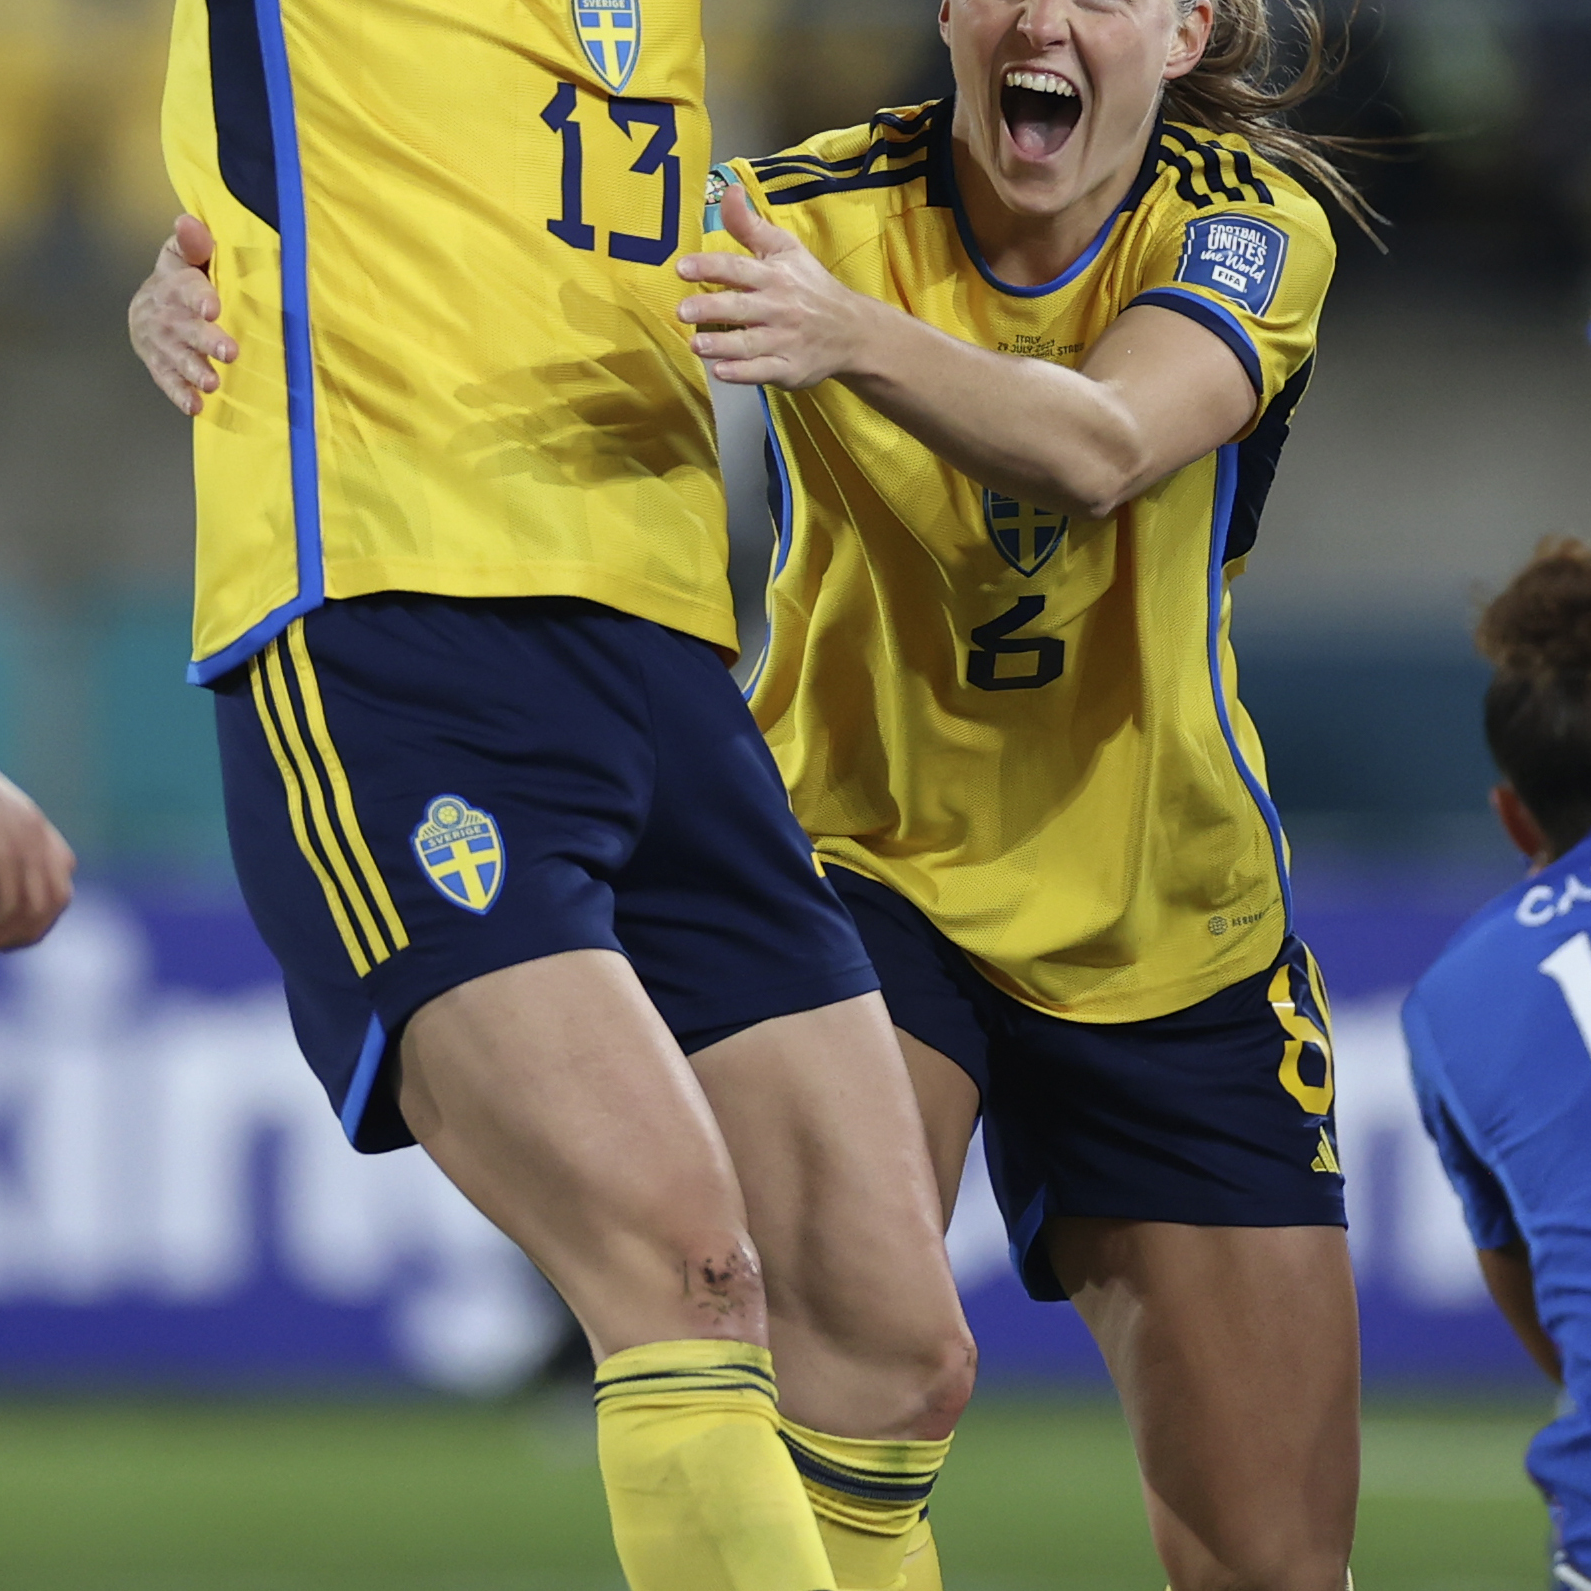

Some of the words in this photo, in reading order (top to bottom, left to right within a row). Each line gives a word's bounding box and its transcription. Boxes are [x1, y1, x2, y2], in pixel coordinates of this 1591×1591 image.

[540, 81, 681, 267] 13
[1207, 232, 1267, 266] UNITES
[1210, 224, 1267, 250] FOOTBALL
[1218, 270, 1241, 287] FIFA
[1225, 251, 1266, 285] World
[1010, 344, 1033, 354] JULY
[1015, 334, 1042, 344] ITALY
[966, 594, 1065, 692] 6
[427, 824, 483, 848] SVERIGE
